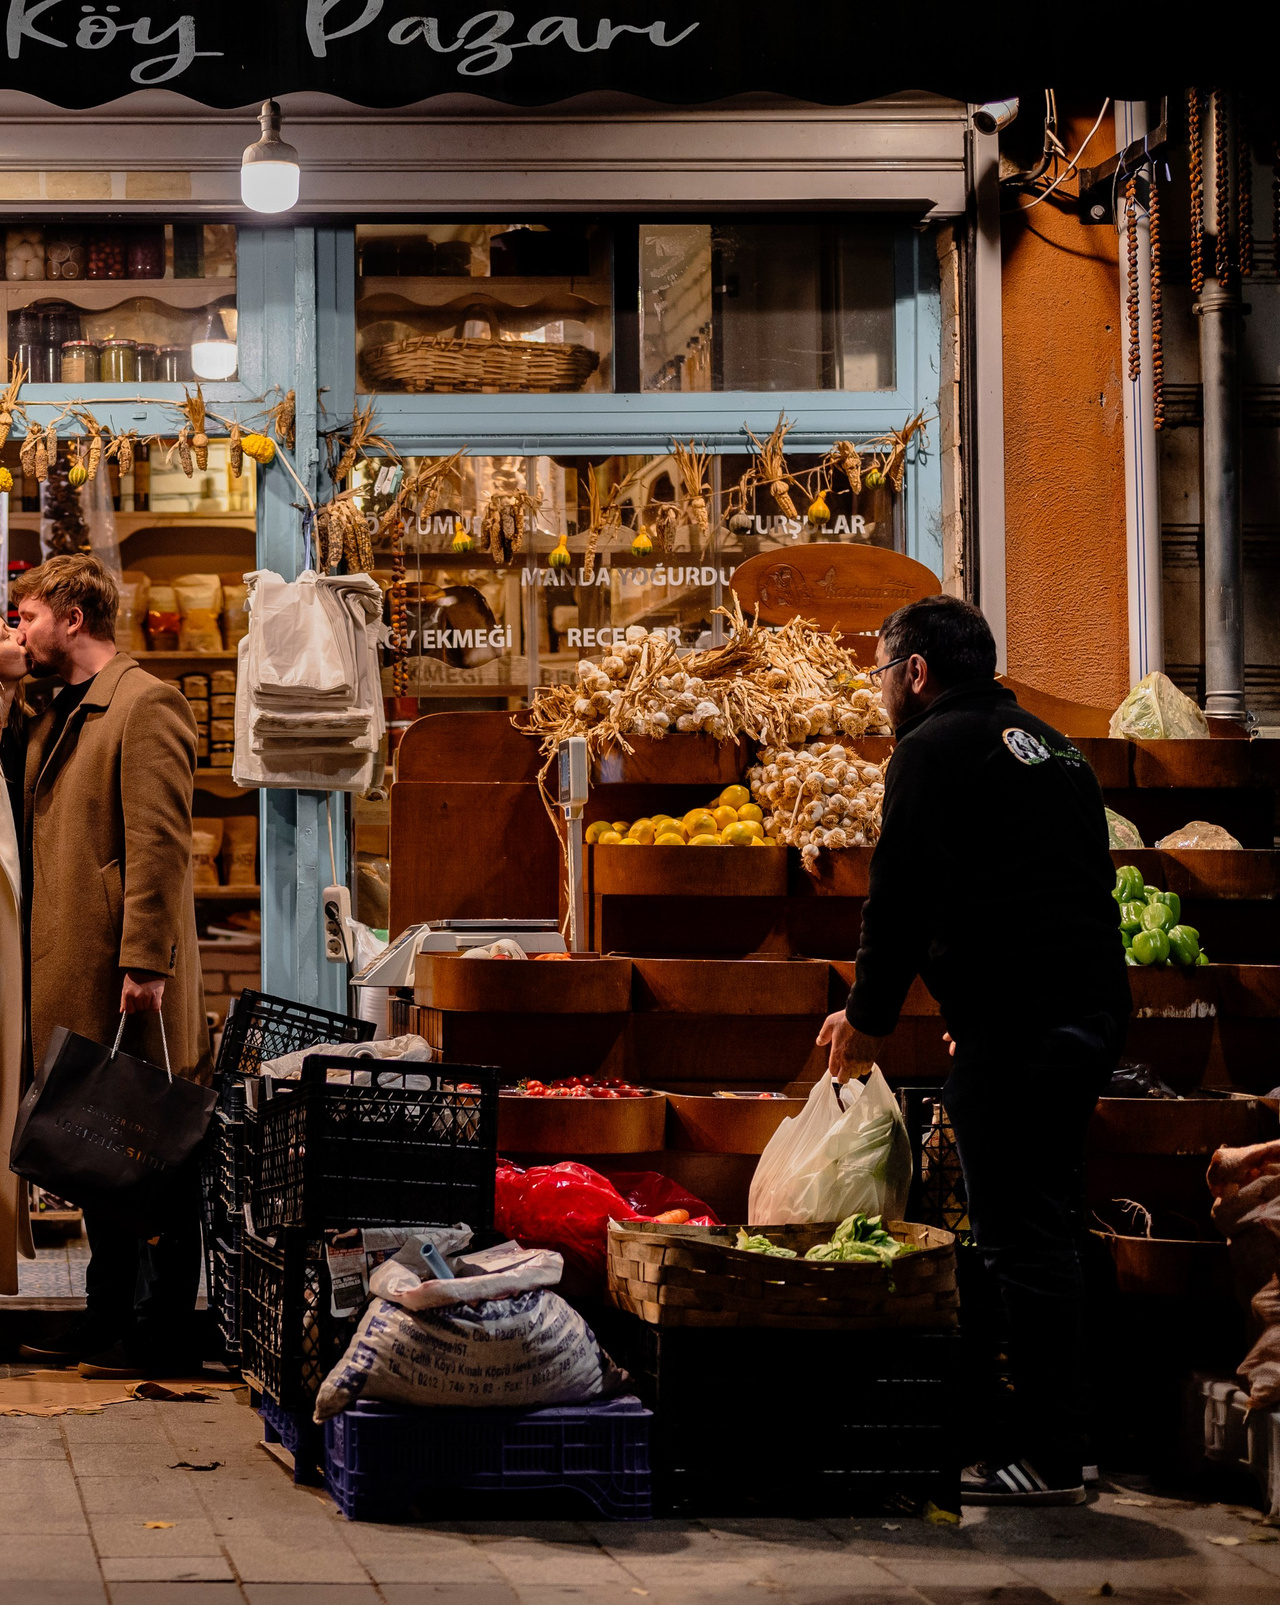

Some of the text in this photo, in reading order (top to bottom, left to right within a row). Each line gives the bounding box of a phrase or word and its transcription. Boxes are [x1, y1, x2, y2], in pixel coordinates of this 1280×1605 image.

[5, 0, 224, 83] Köy
[305, 0, 701, 75] Pazarı
[521, 563, 735, 586] MANDA YOĞURDU
[379, 625, 512, 649] ÖY EKMEĞİ
[568, 627, 682, 647] RECER
